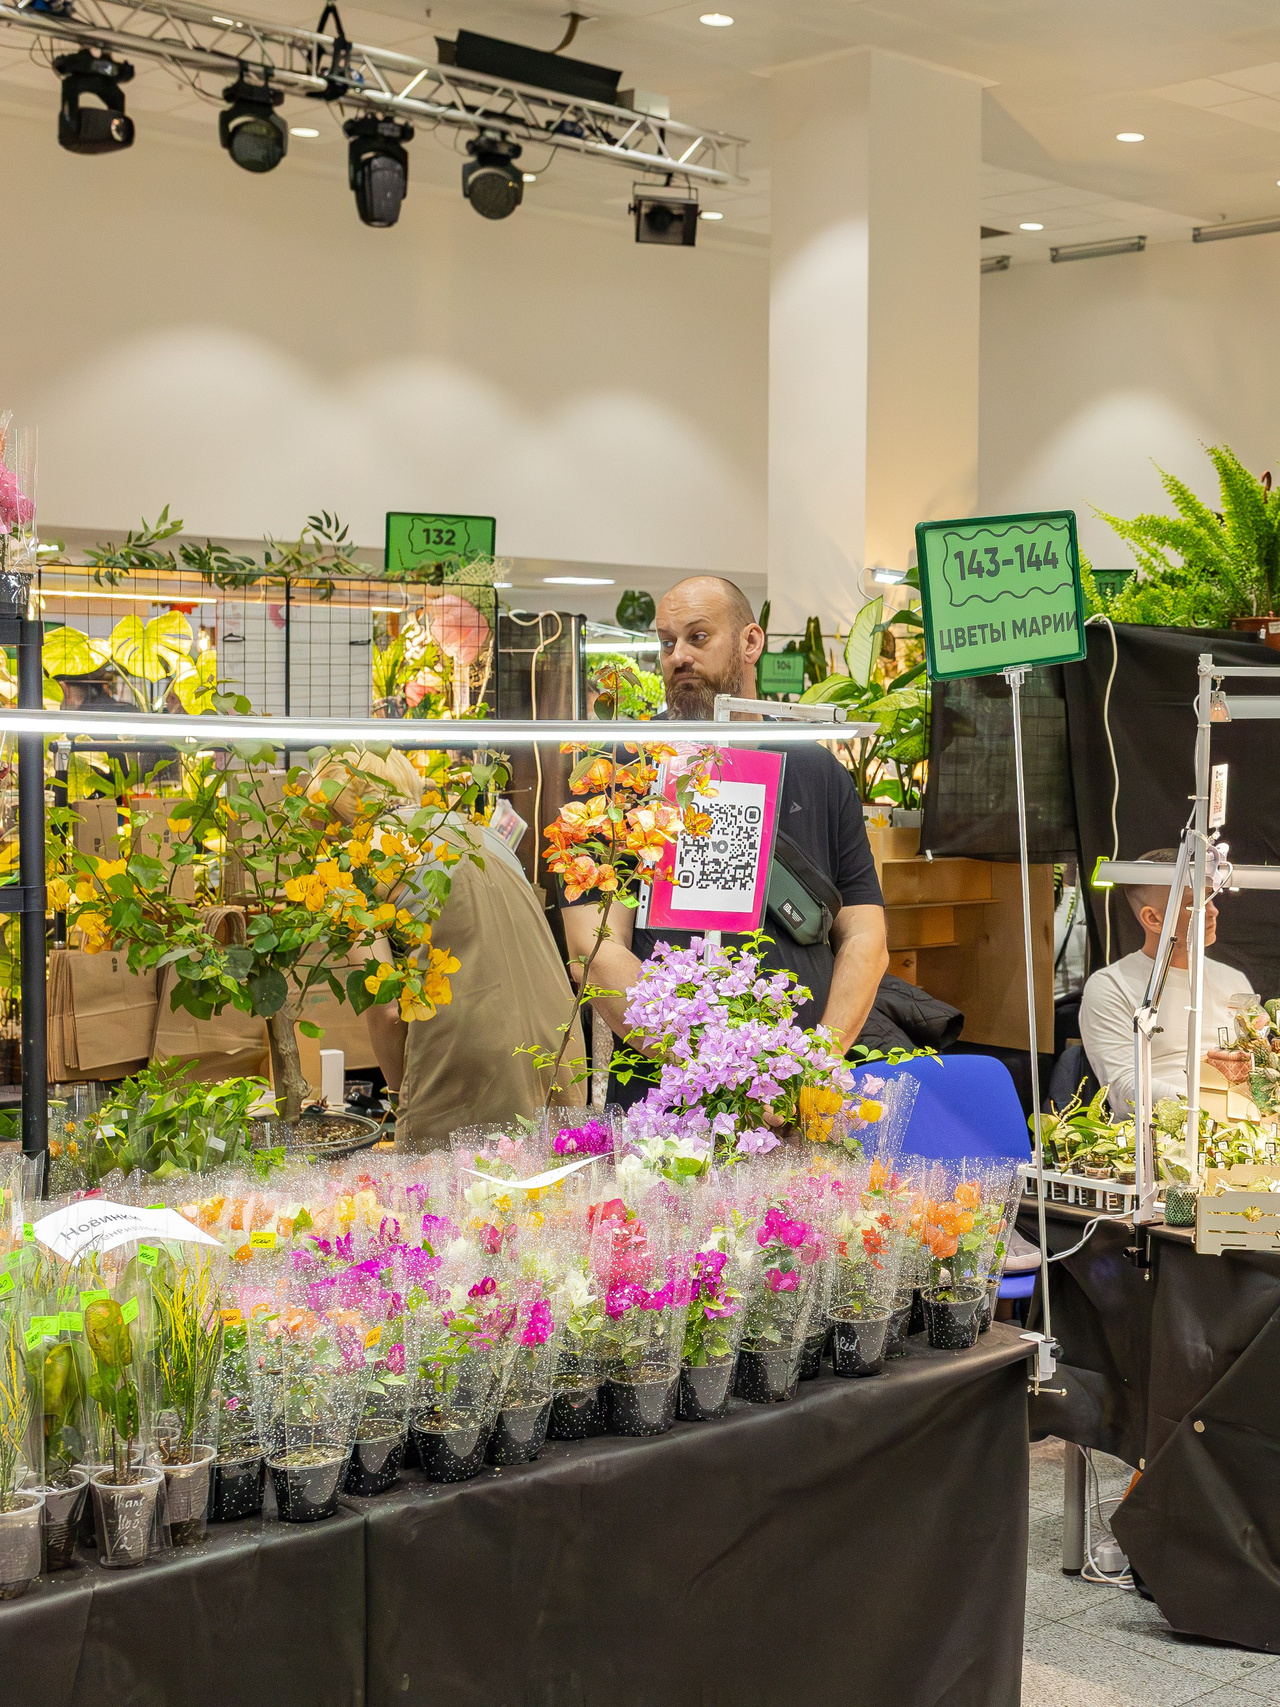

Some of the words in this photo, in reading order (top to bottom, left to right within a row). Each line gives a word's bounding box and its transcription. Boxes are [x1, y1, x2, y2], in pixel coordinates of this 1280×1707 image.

[422, 528, 456, 546] 132
[953, 540, 1059, 581] 143-144
[939, 620, 1007, 653] ЦВЕТЫ
[1012, 610, 1078, 640] МАРИИ
